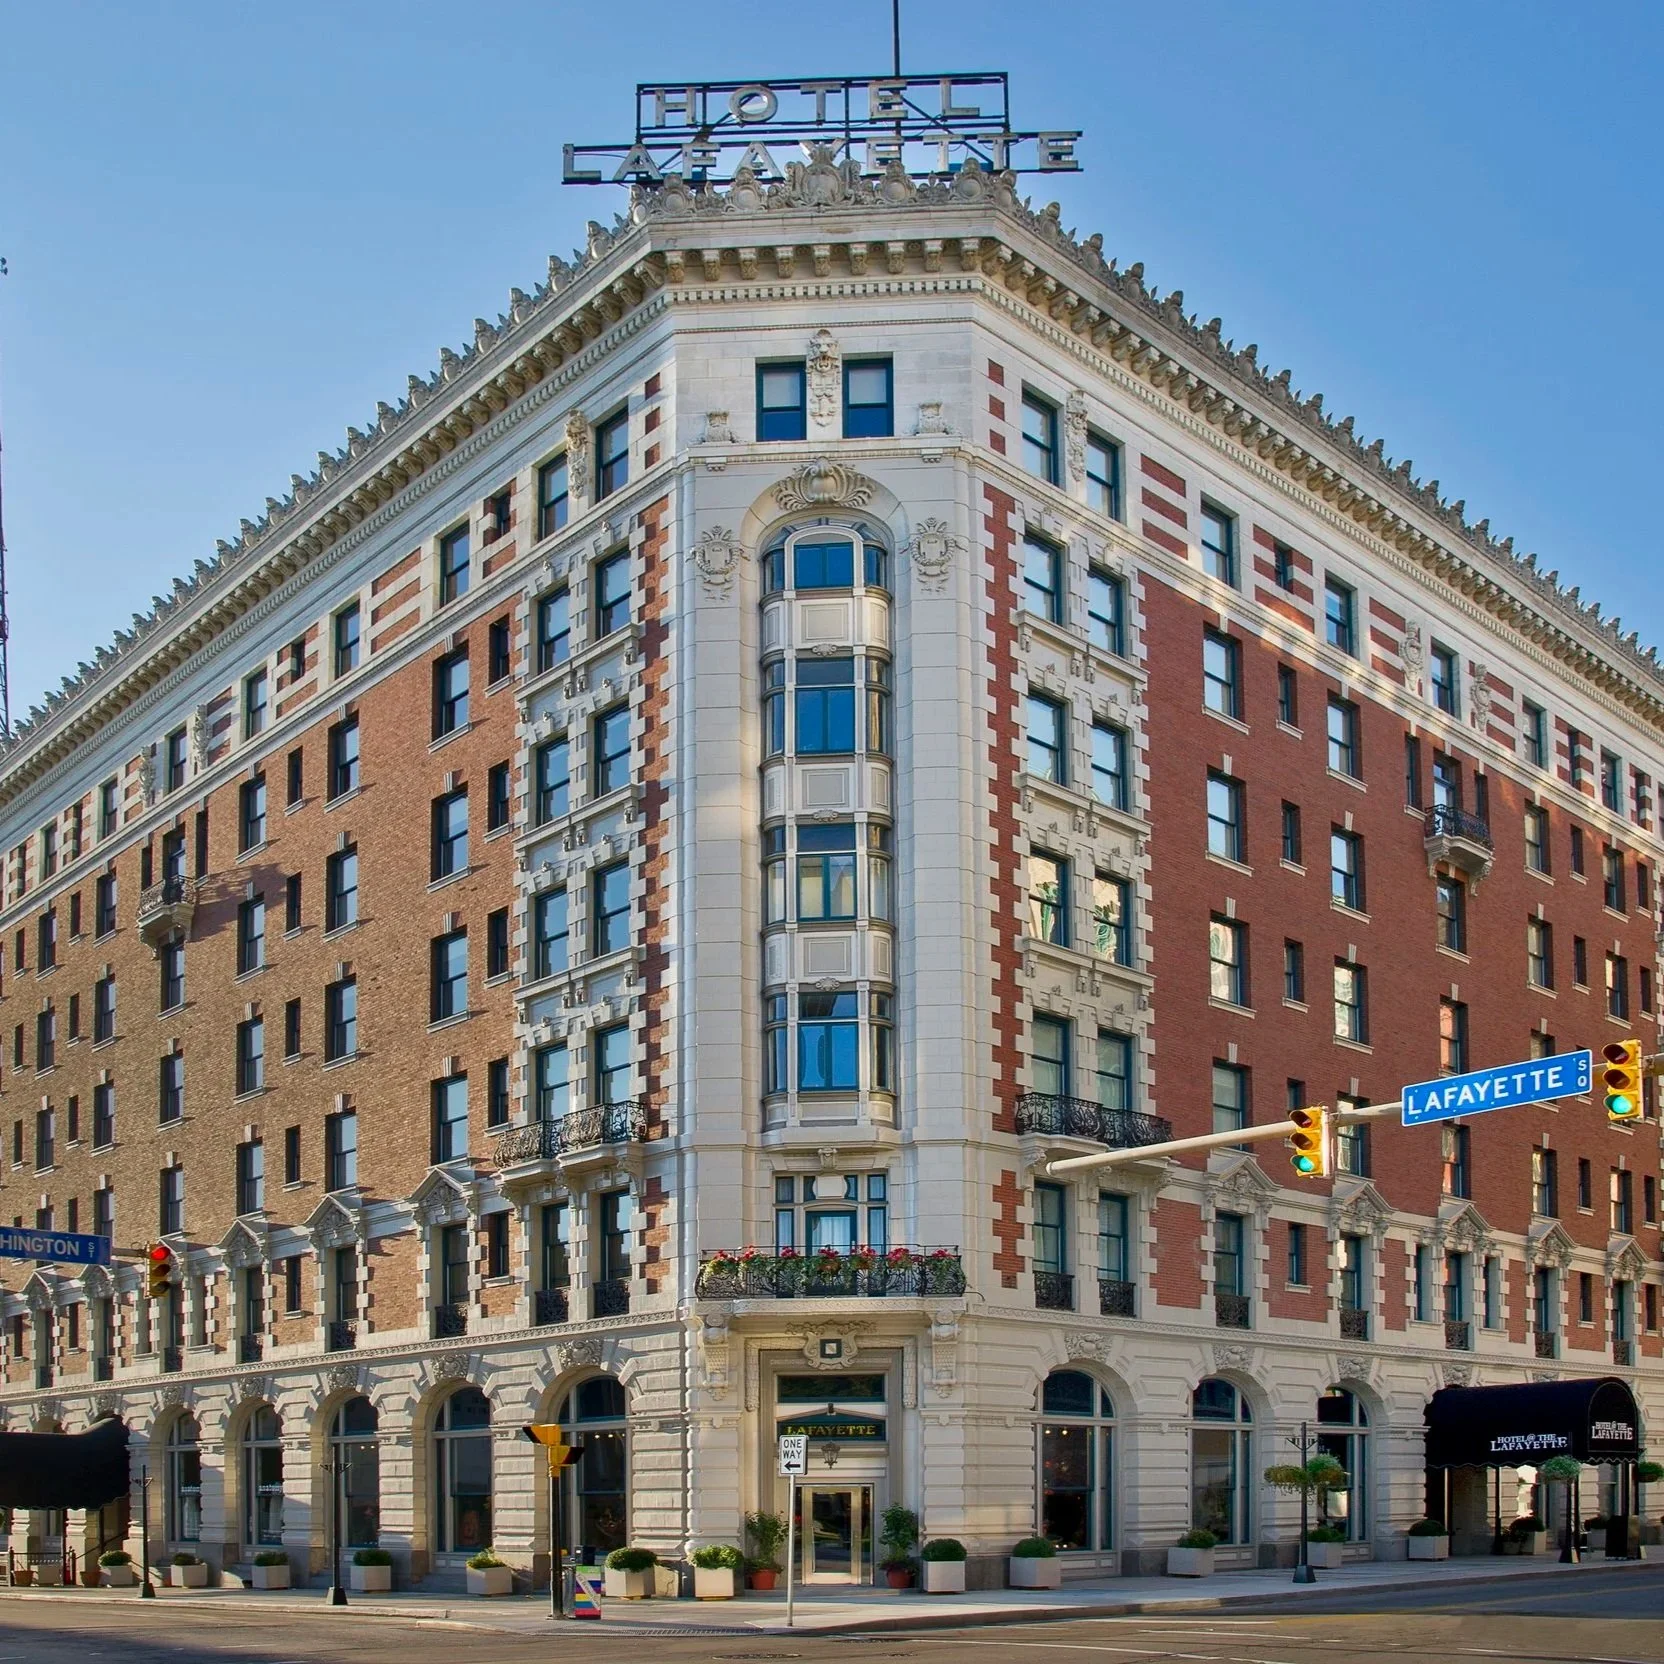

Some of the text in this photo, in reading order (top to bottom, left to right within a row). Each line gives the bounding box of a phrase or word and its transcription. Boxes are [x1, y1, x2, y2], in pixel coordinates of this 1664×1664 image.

[654, 78, 981, 127] HOTEL
[1408, 1060, 1587, 1115] LAFAYETTE SQ
[0, 1234, 95, 1258] HINGTON ST
[786, 1425, 876, 1436] LAFAYETTE
[1591, 1425, 1633, 1440] LAFAYETTE
[1595, 1421, 1611, 1430] HOTEL
[1617, 1422, 1628, 1431] THE
[783, 1439, 802, 1449] ONE
[1490, 1436, 1568, 1452] LAFAYETTE
[1497, 1435, 1526, 1444] HOTEL
[1537, 1433, 1557, 1442] THE
[782, 1450, 802, 1460] WAY
